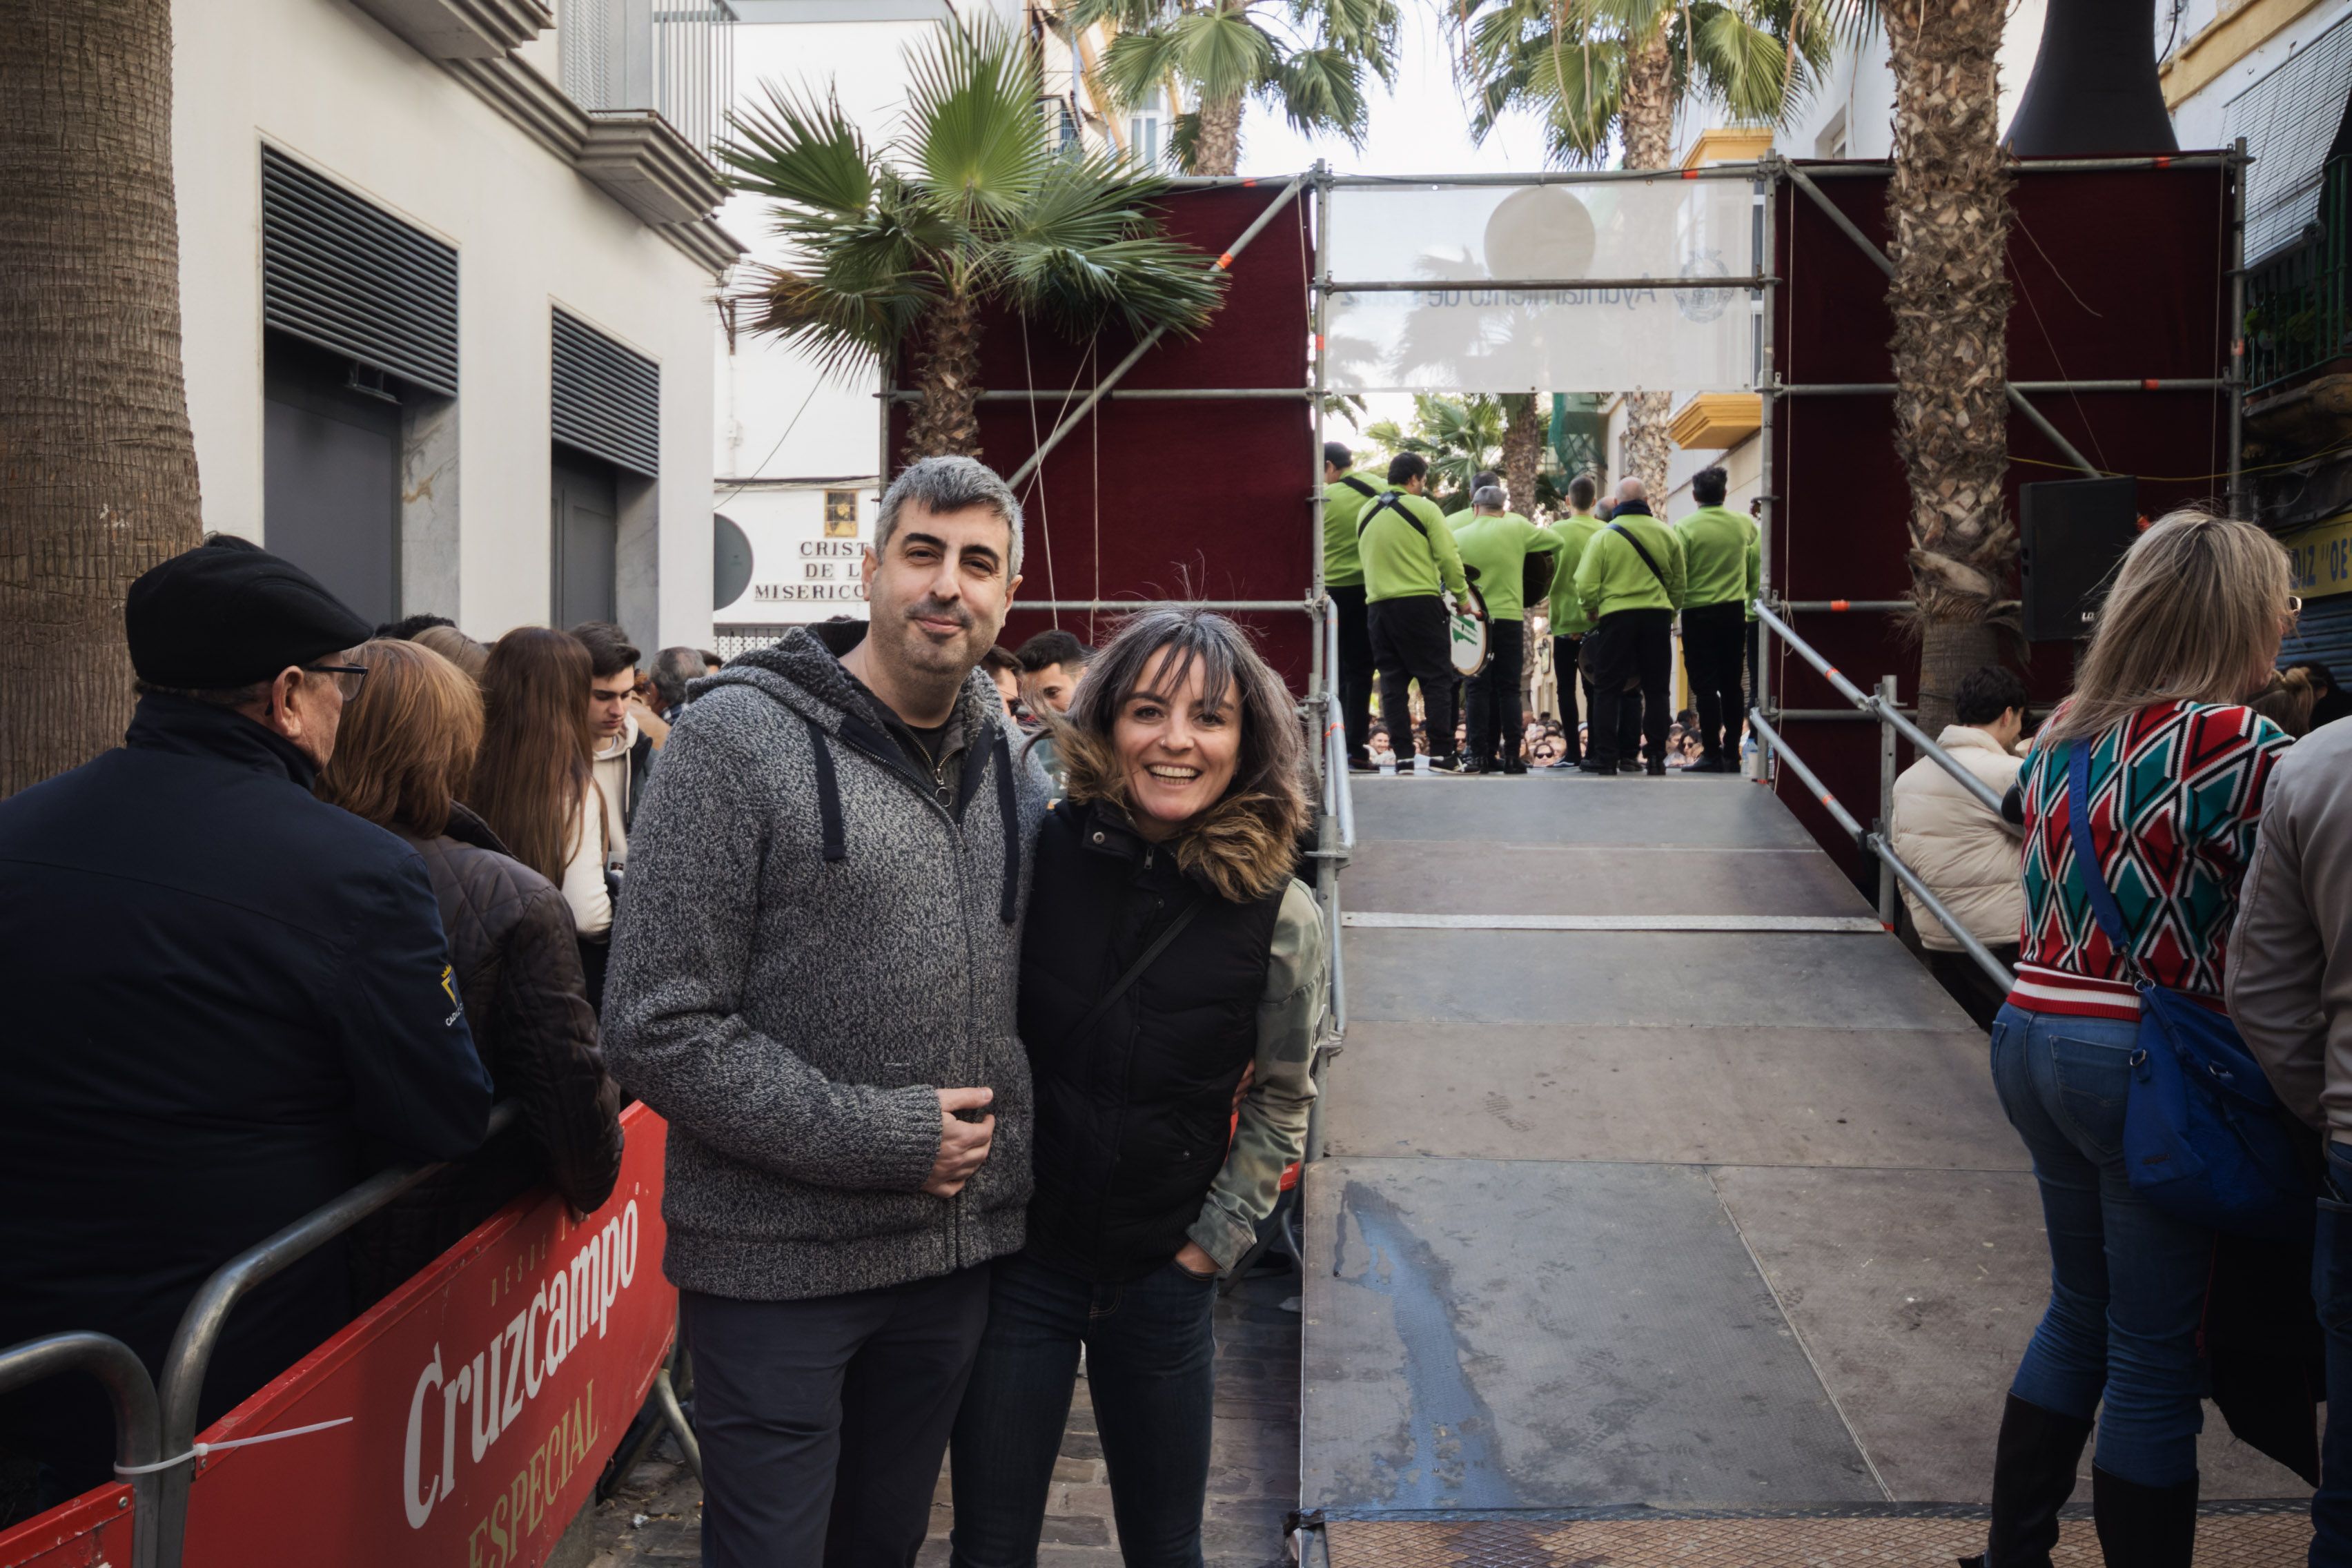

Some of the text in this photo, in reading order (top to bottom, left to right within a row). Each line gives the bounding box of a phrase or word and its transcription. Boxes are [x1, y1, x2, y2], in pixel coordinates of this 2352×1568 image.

[801, 541, 869, 556] CRIST
[805, 563, 860, 578] DE L
[755, 585, 865, 599] MISERICO
[491, 1233, 546, 1306] DESDE
[404, 1199, 638, 1529] Cruzcampo
[469, 1378, 599, 1568] ESPECIAL
